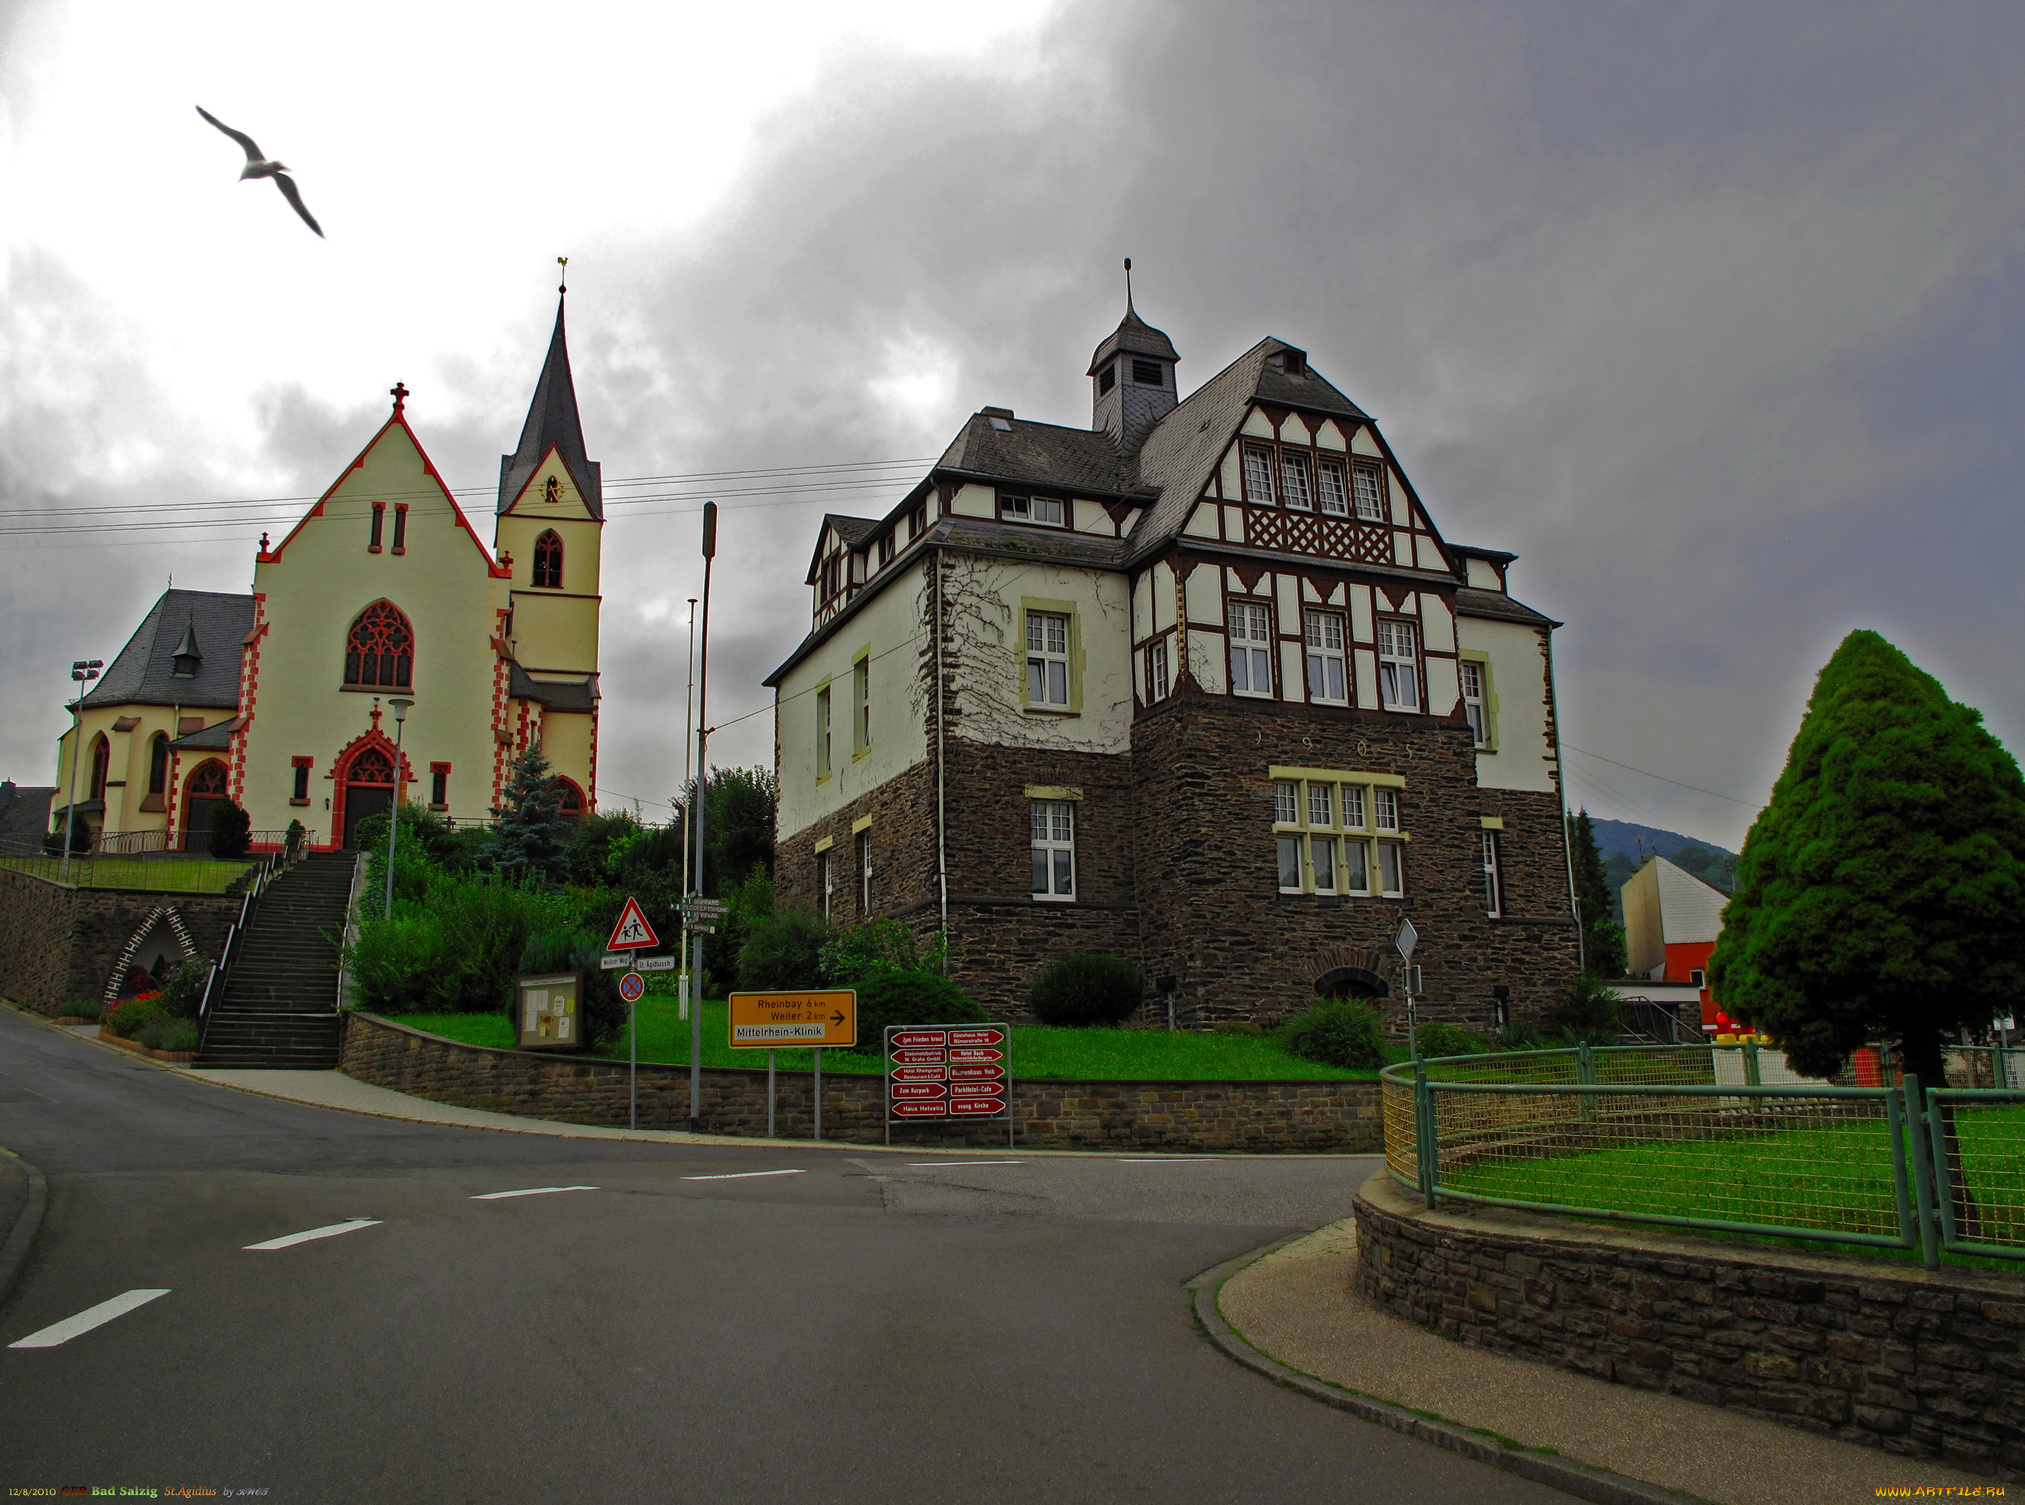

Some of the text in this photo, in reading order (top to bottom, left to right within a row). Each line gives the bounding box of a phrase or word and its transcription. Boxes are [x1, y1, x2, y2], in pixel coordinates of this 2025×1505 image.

[757, 1000, 802, 1009] Rheinbay
[806, 999, 812, 1007] 6
[771, 1011, 826, 1020] Weiler 2 km
[737, 1027, 822, 1037] Mittelrhein-Klinik
